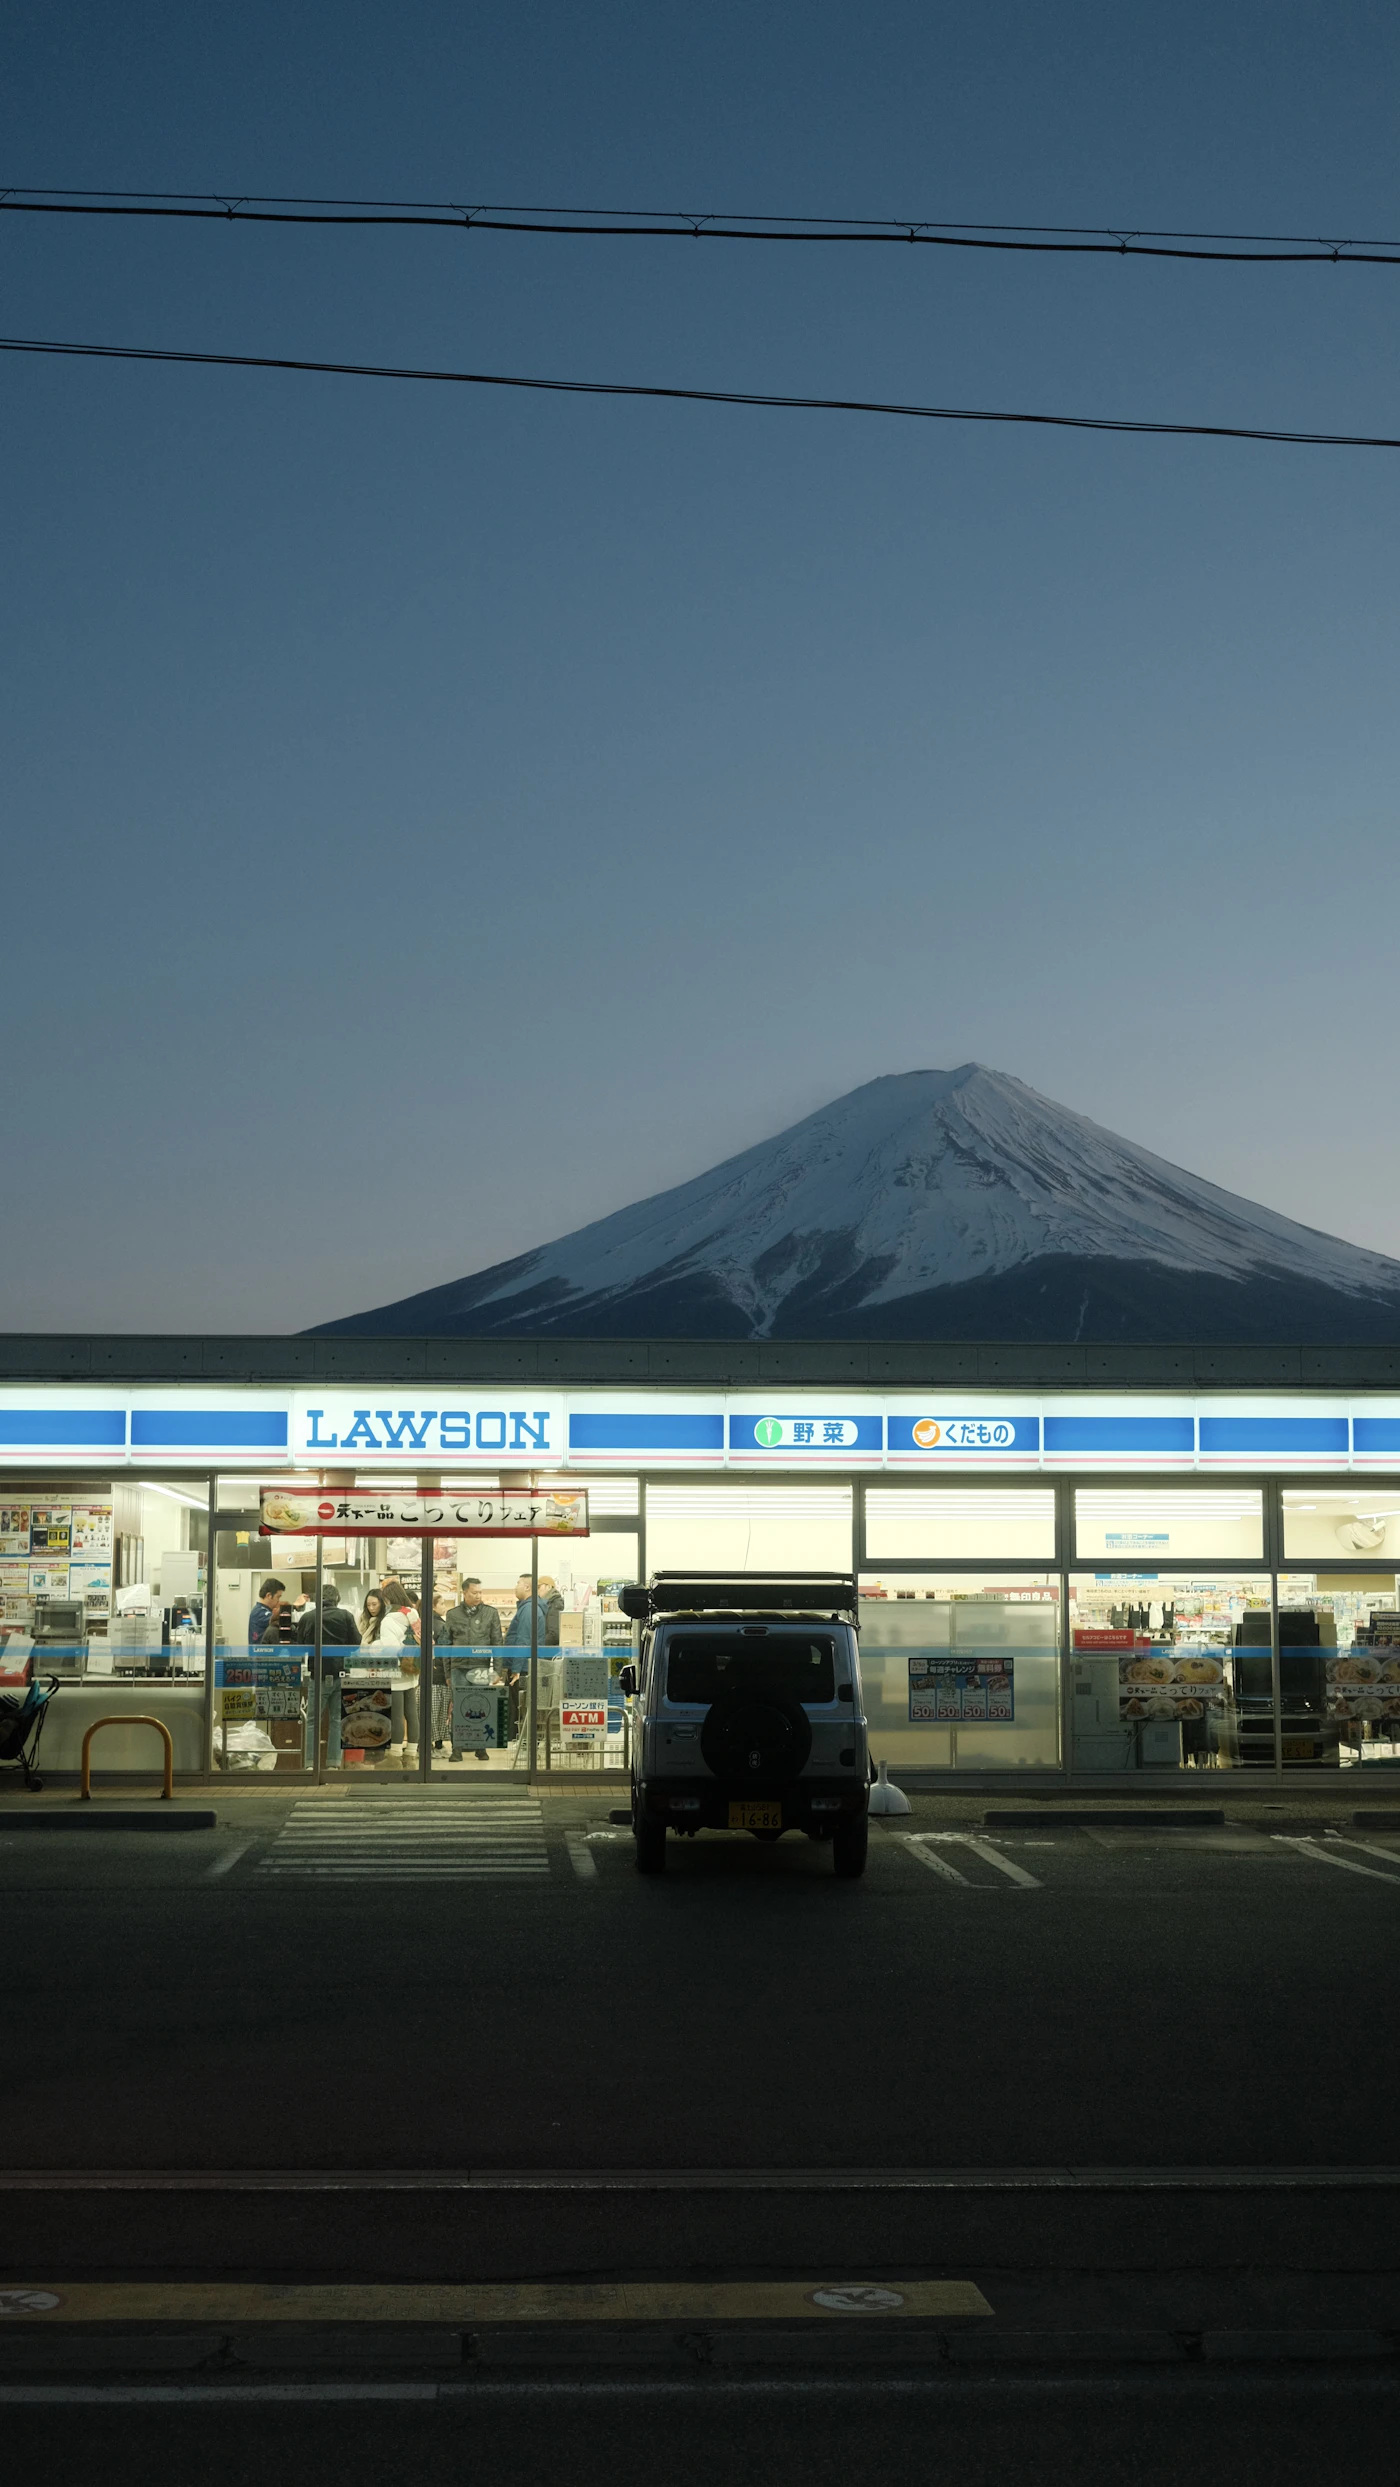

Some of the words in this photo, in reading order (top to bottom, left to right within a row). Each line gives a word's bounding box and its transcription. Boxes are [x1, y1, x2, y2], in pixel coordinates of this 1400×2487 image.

[307, 1410, 550, 1449] LAWSON
[793, 1422, 844, 1443] 野菜
[945, 1423, 1009, 1444] くだもの
[562, 1702, 604, 1710] ローソン銀行
[569, 1712, 599, 1723] ATM
[742, 1813, 778, 1826] 16-86
